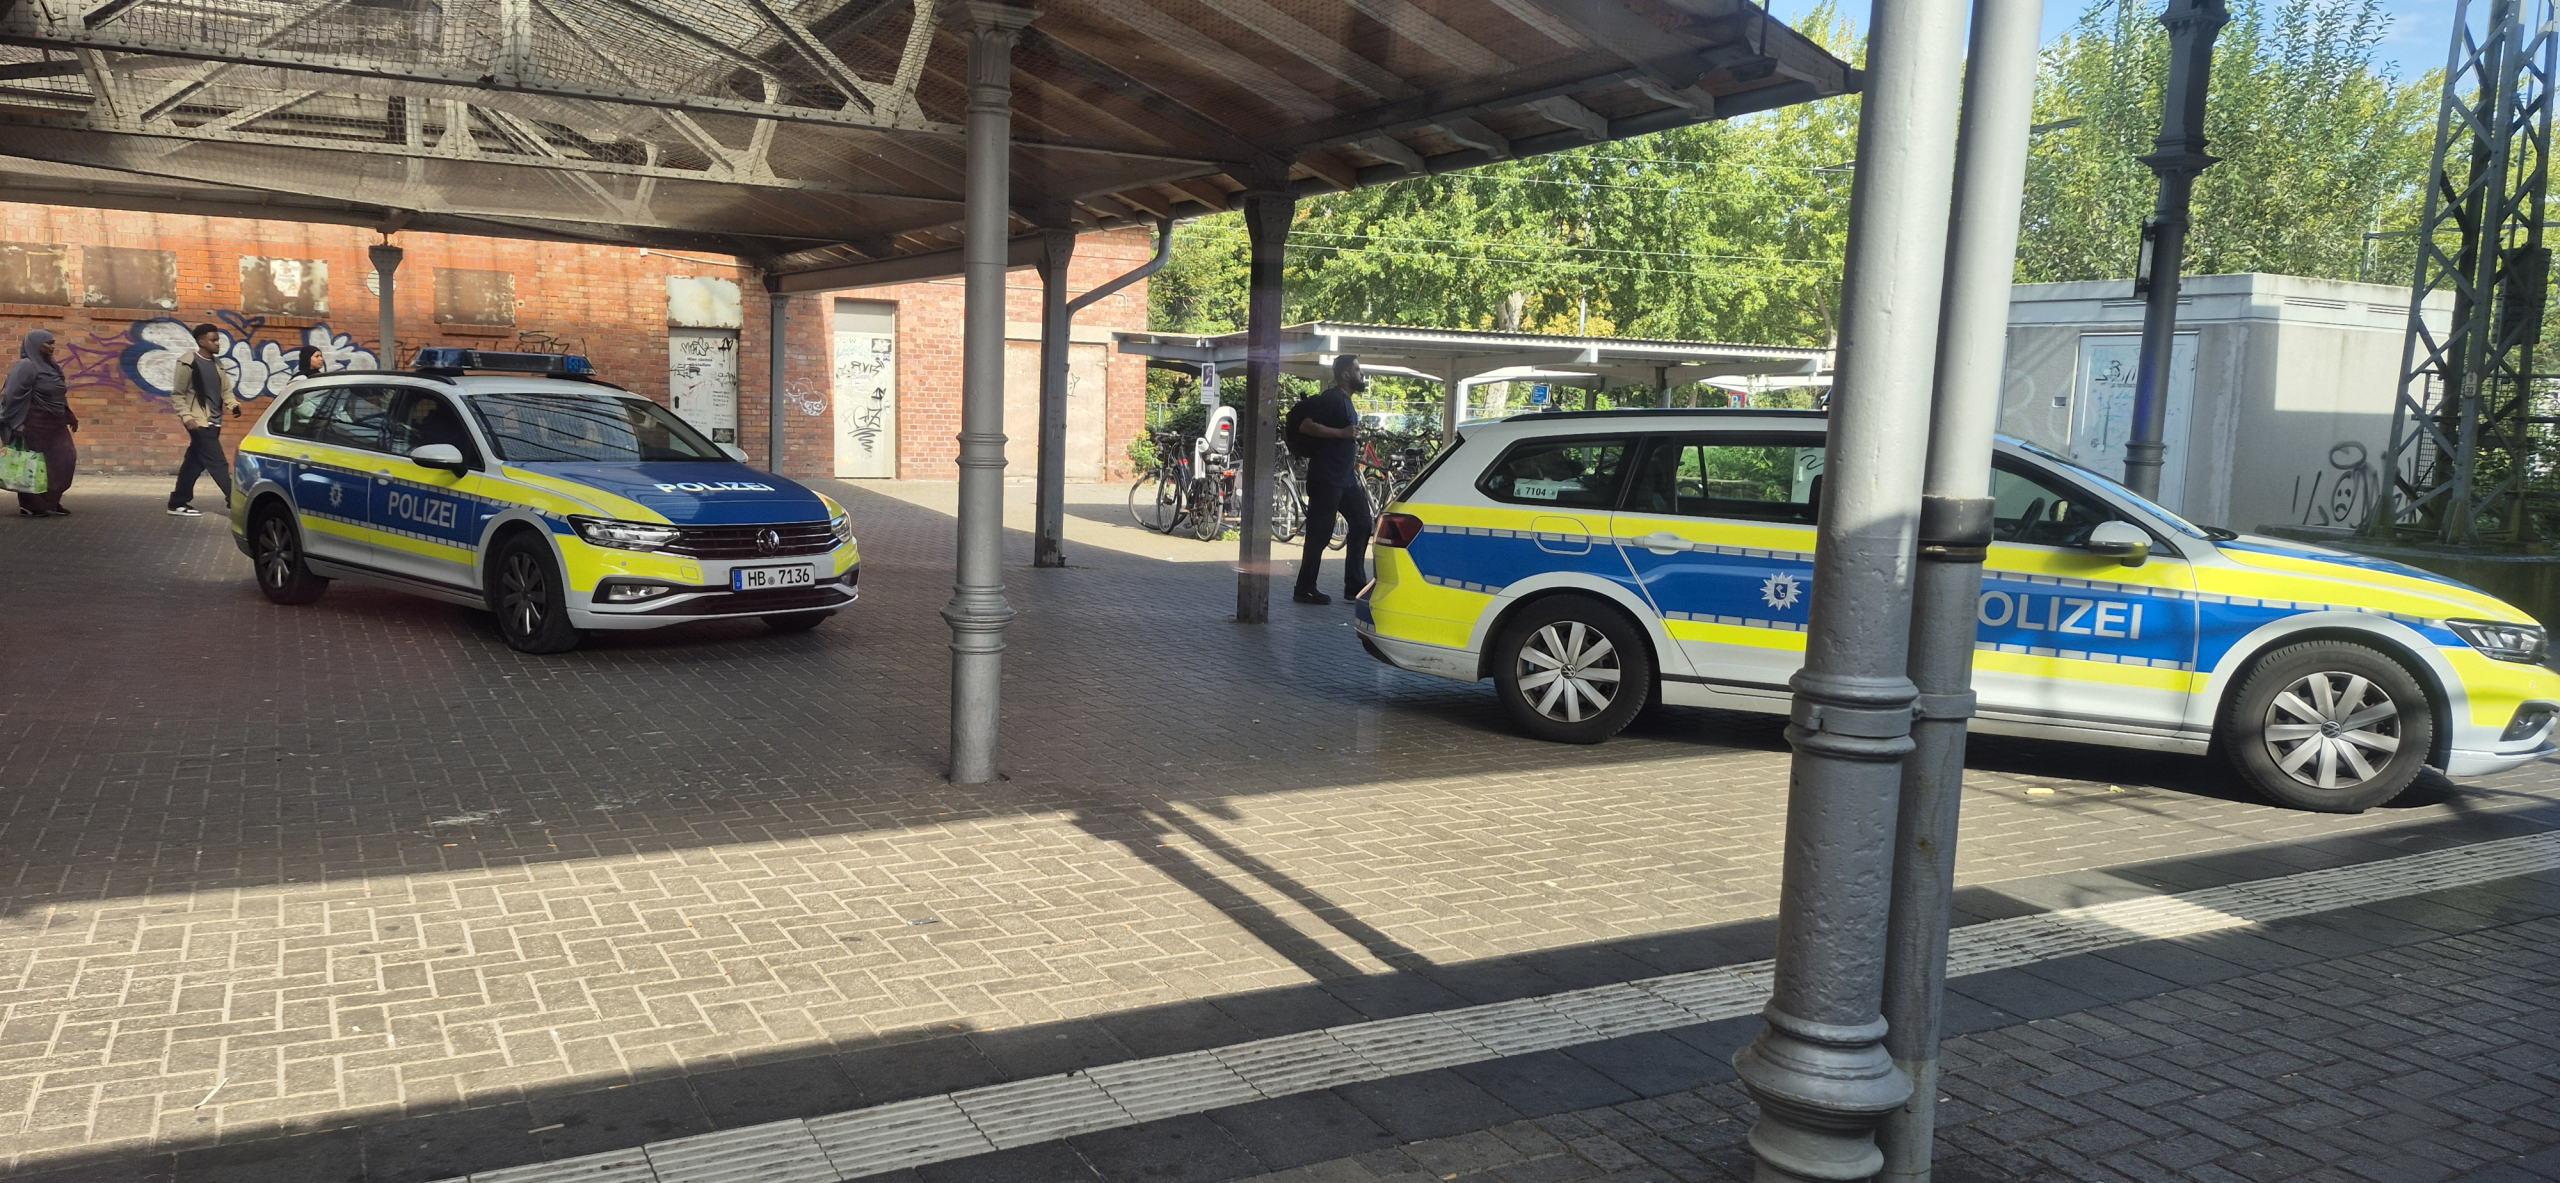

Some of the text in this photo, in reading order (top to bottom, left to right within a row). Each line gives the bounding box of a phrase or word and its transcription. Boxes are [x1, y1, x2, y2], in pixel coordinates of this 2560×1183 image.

[653, 481, 775, 493] POLIZEI
[1525, 486, 1546, 497] 7104
[387, 490, 458, 529] POLIZEI
[747, 568, 810, 587] HB 7136
[1977, 590, 2143, 640] OLIZEI
